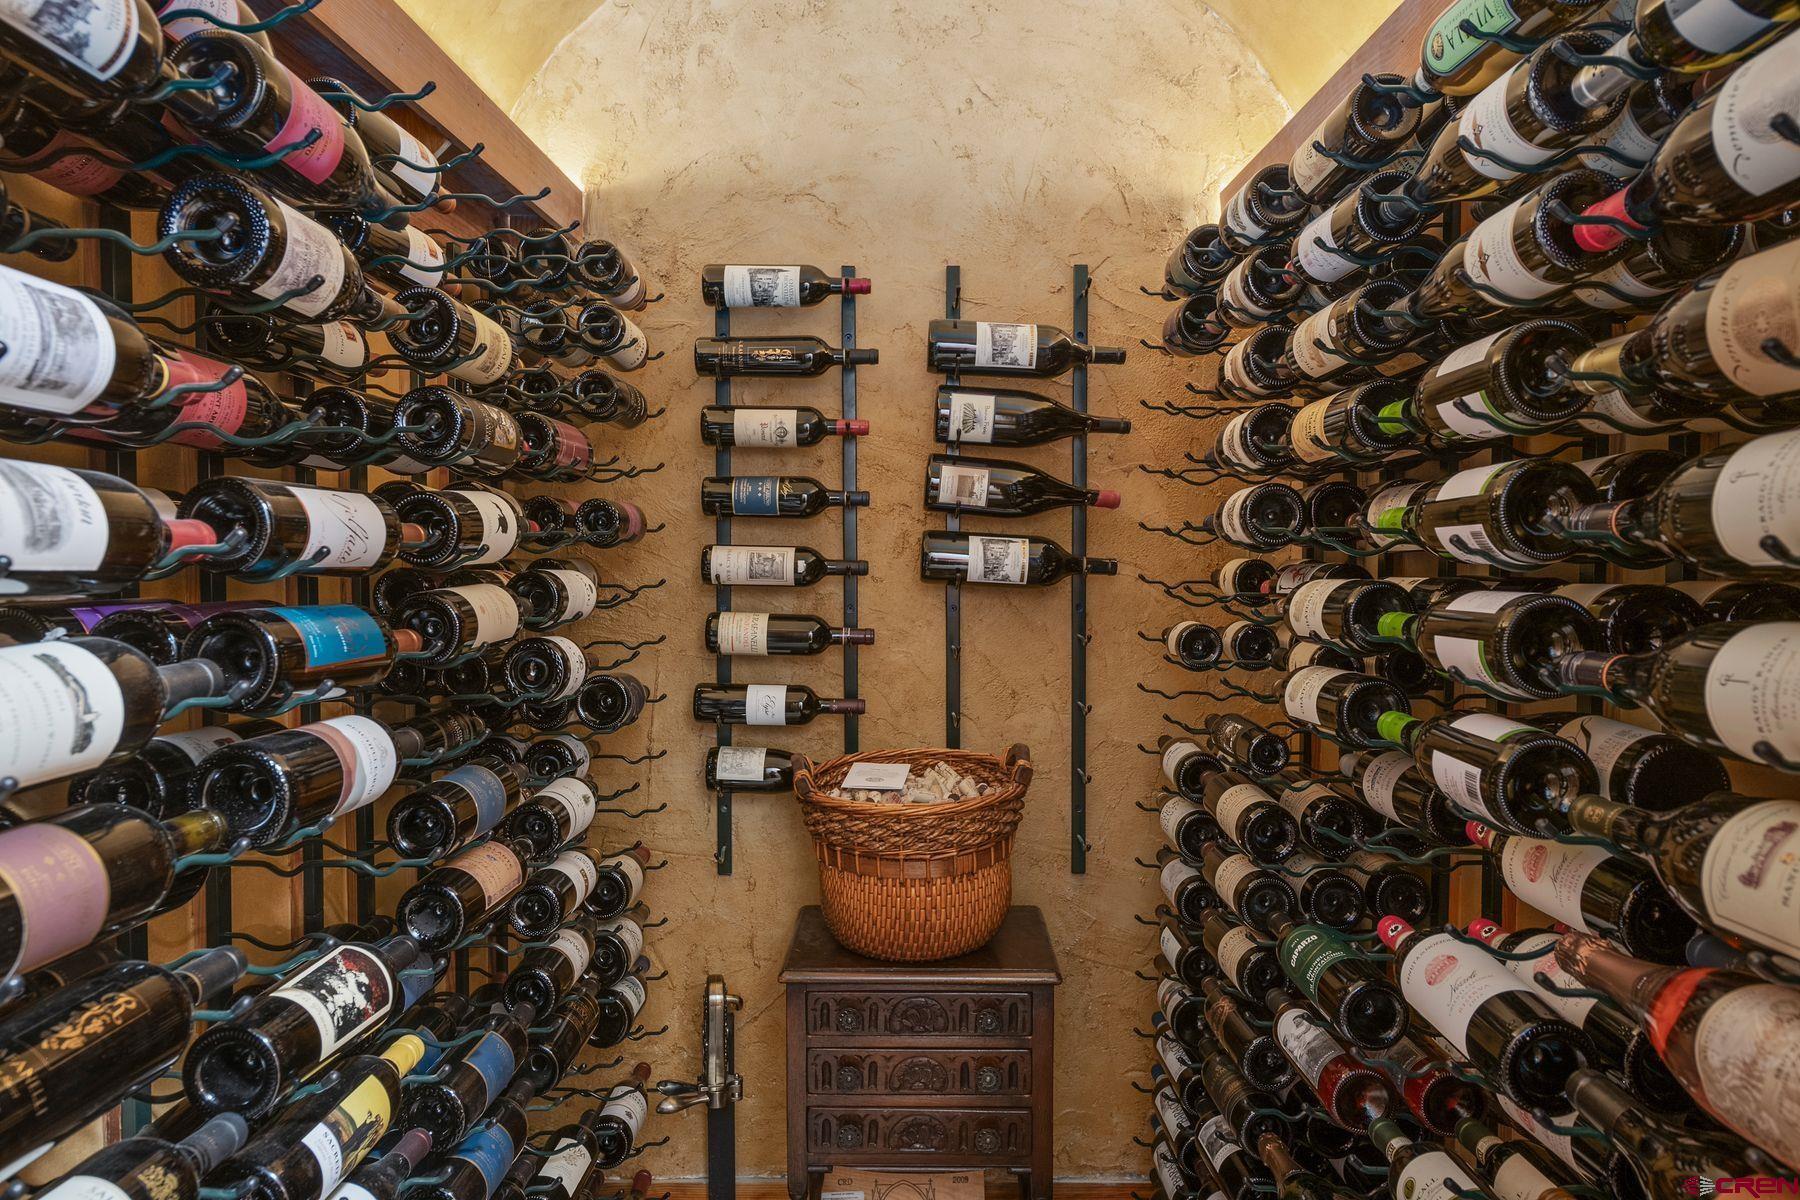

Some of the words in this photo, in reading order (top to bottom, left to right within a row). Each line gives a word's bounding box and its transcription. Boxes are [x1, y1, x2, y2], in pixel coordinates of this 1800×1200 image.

[1290, 933, 1319, 968] CAPARZO
[1306, 949, 1332, 981] BRUNELLO
[836, 1178, 854, 1188] CRD
